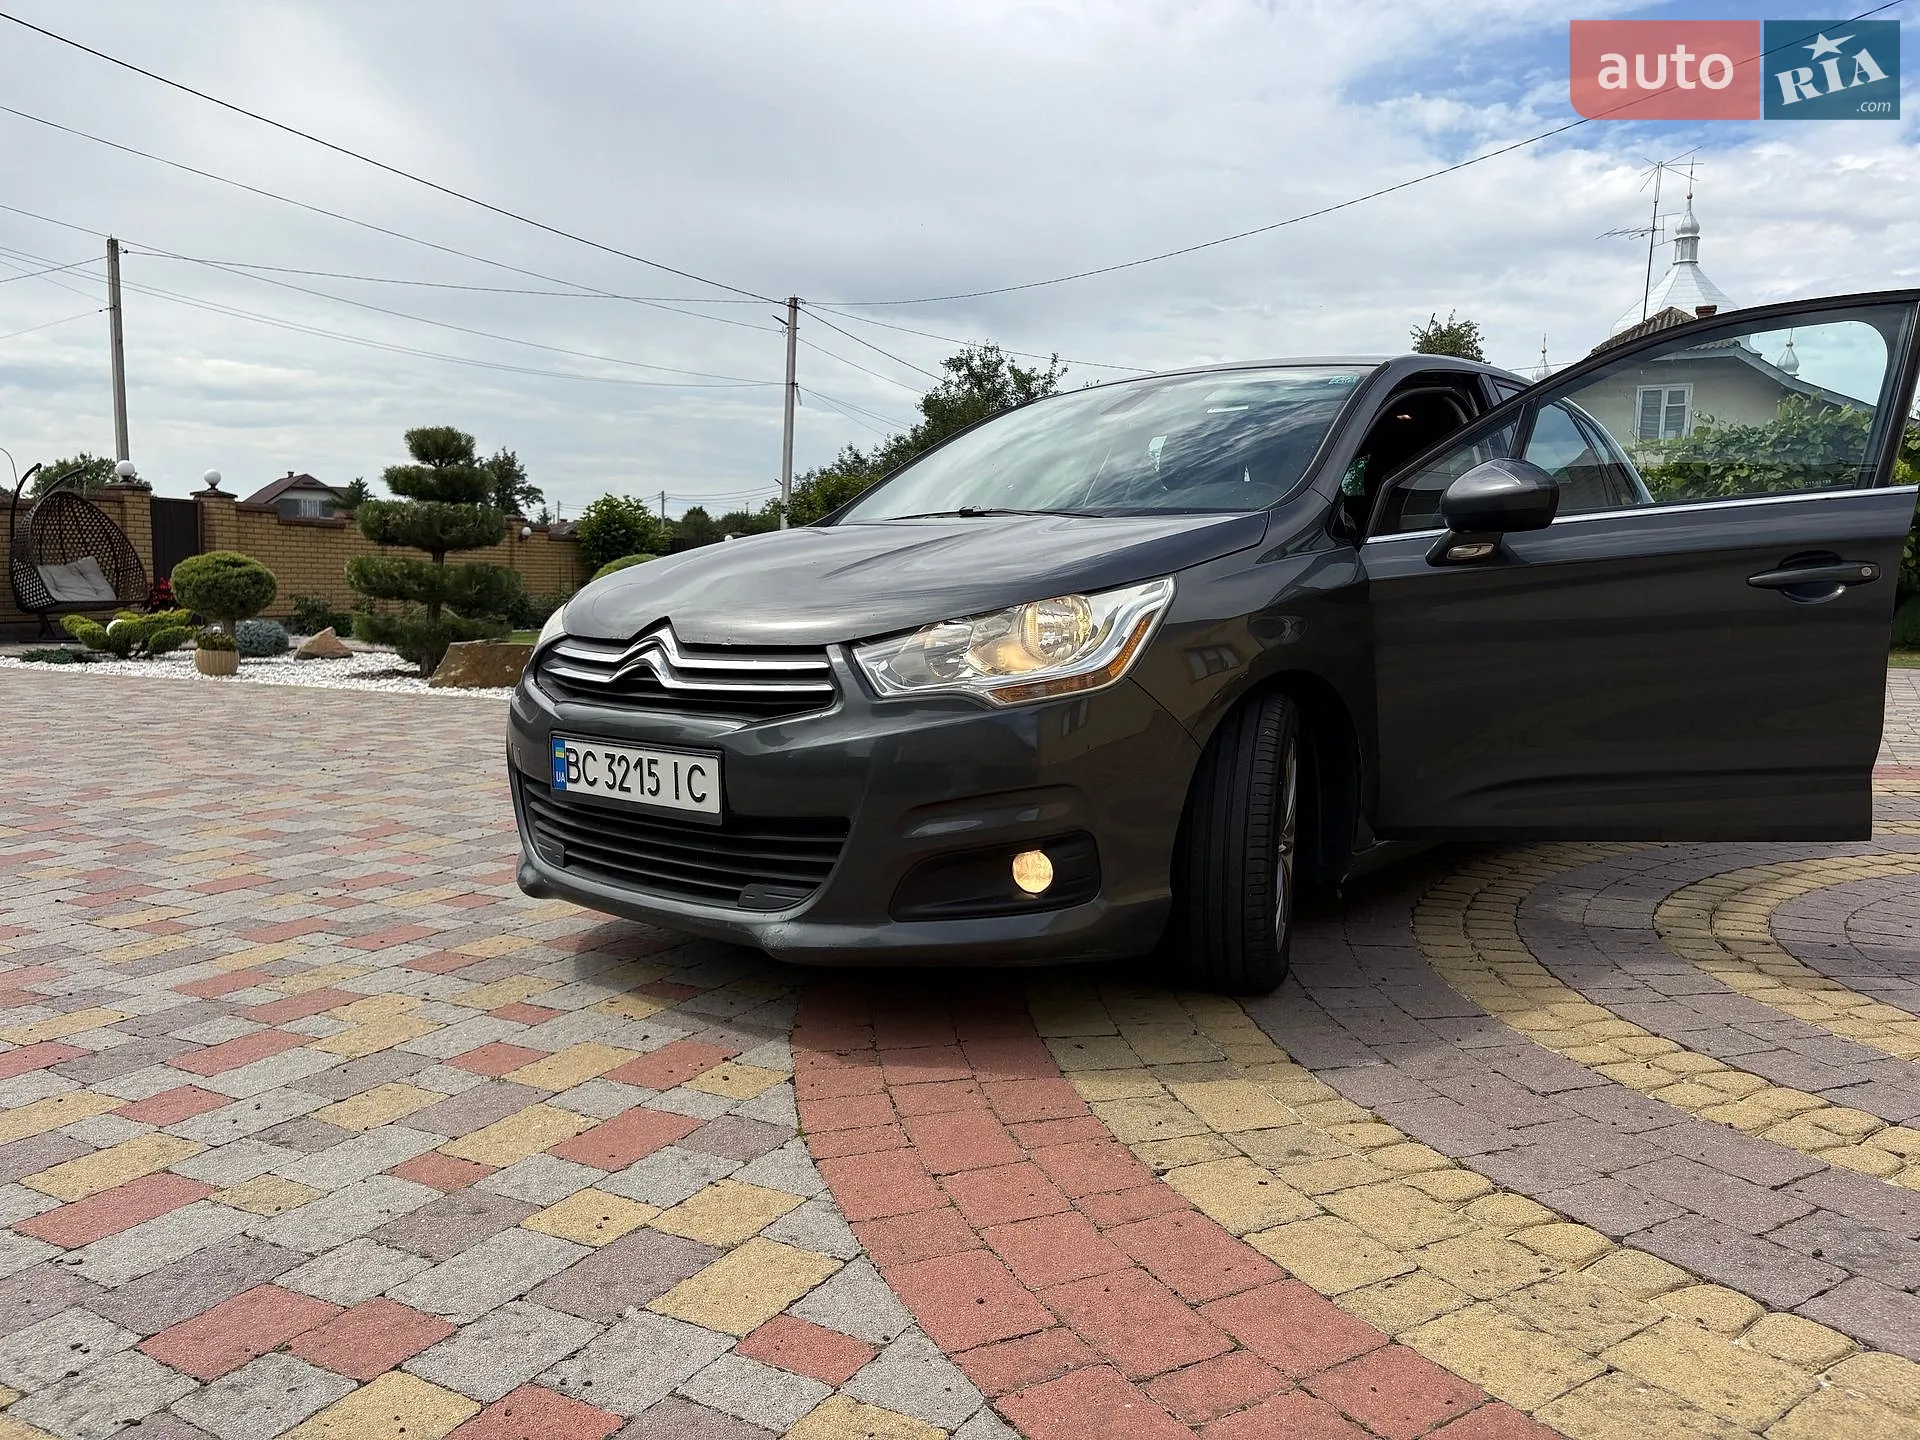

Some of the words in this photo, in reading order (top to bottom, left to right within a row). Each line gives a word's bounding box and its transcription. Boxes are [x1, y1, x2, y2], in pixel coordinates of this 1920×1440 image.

[555, 771, 566, 783] UA
[566, 747, 598, 787] BC
[604, 753, 660, 796] 3215
[673, 761, 706, 803] IC
